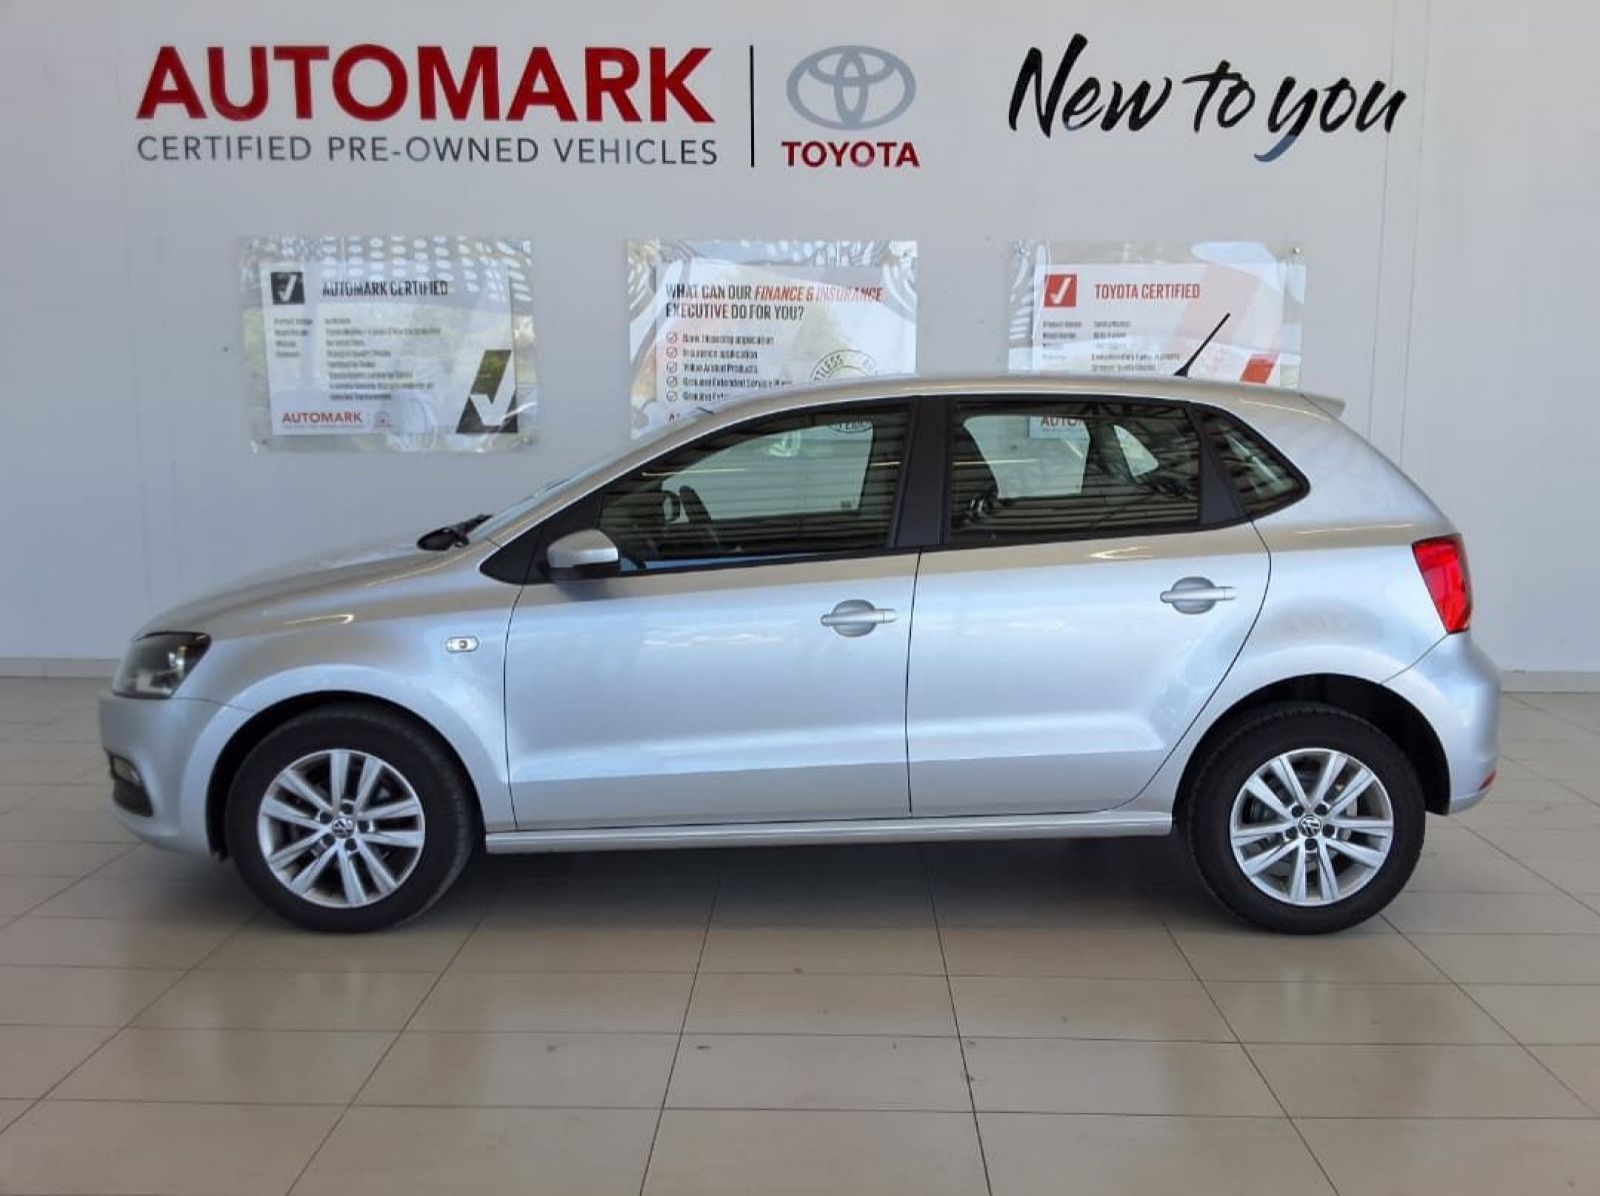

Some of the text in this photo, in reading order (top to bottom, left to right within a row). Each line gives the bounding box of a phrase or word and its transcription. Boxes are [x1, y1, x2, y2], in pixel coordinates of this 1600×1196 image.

[136, 44, 714, 125] AUTOMARK
[1007, 33, 1408, 163] New to you
[137, 136, 718, 166] CERTIFIED PRE-OWNED VEHICLES
[781, 140, 921, 169] TOYOTA
[322, 280, 449, 297] AUTOMARK CERTIFIED
[665, 283, 698, 299] WHAT
[701, 284, 726, 300] CAN
[728, 284, 751, 300] OUR
[754, 285, 803, 301] FINANCE
[815, 286, 883, 302] INSURANCE
[1094, 283, 1201, 299] TOYOTA CERTIFIED
[665, 302, 805, 320] EXECUTIVE DO FOR YOU?
[282, 411, 363, 424] AUTOMARK
